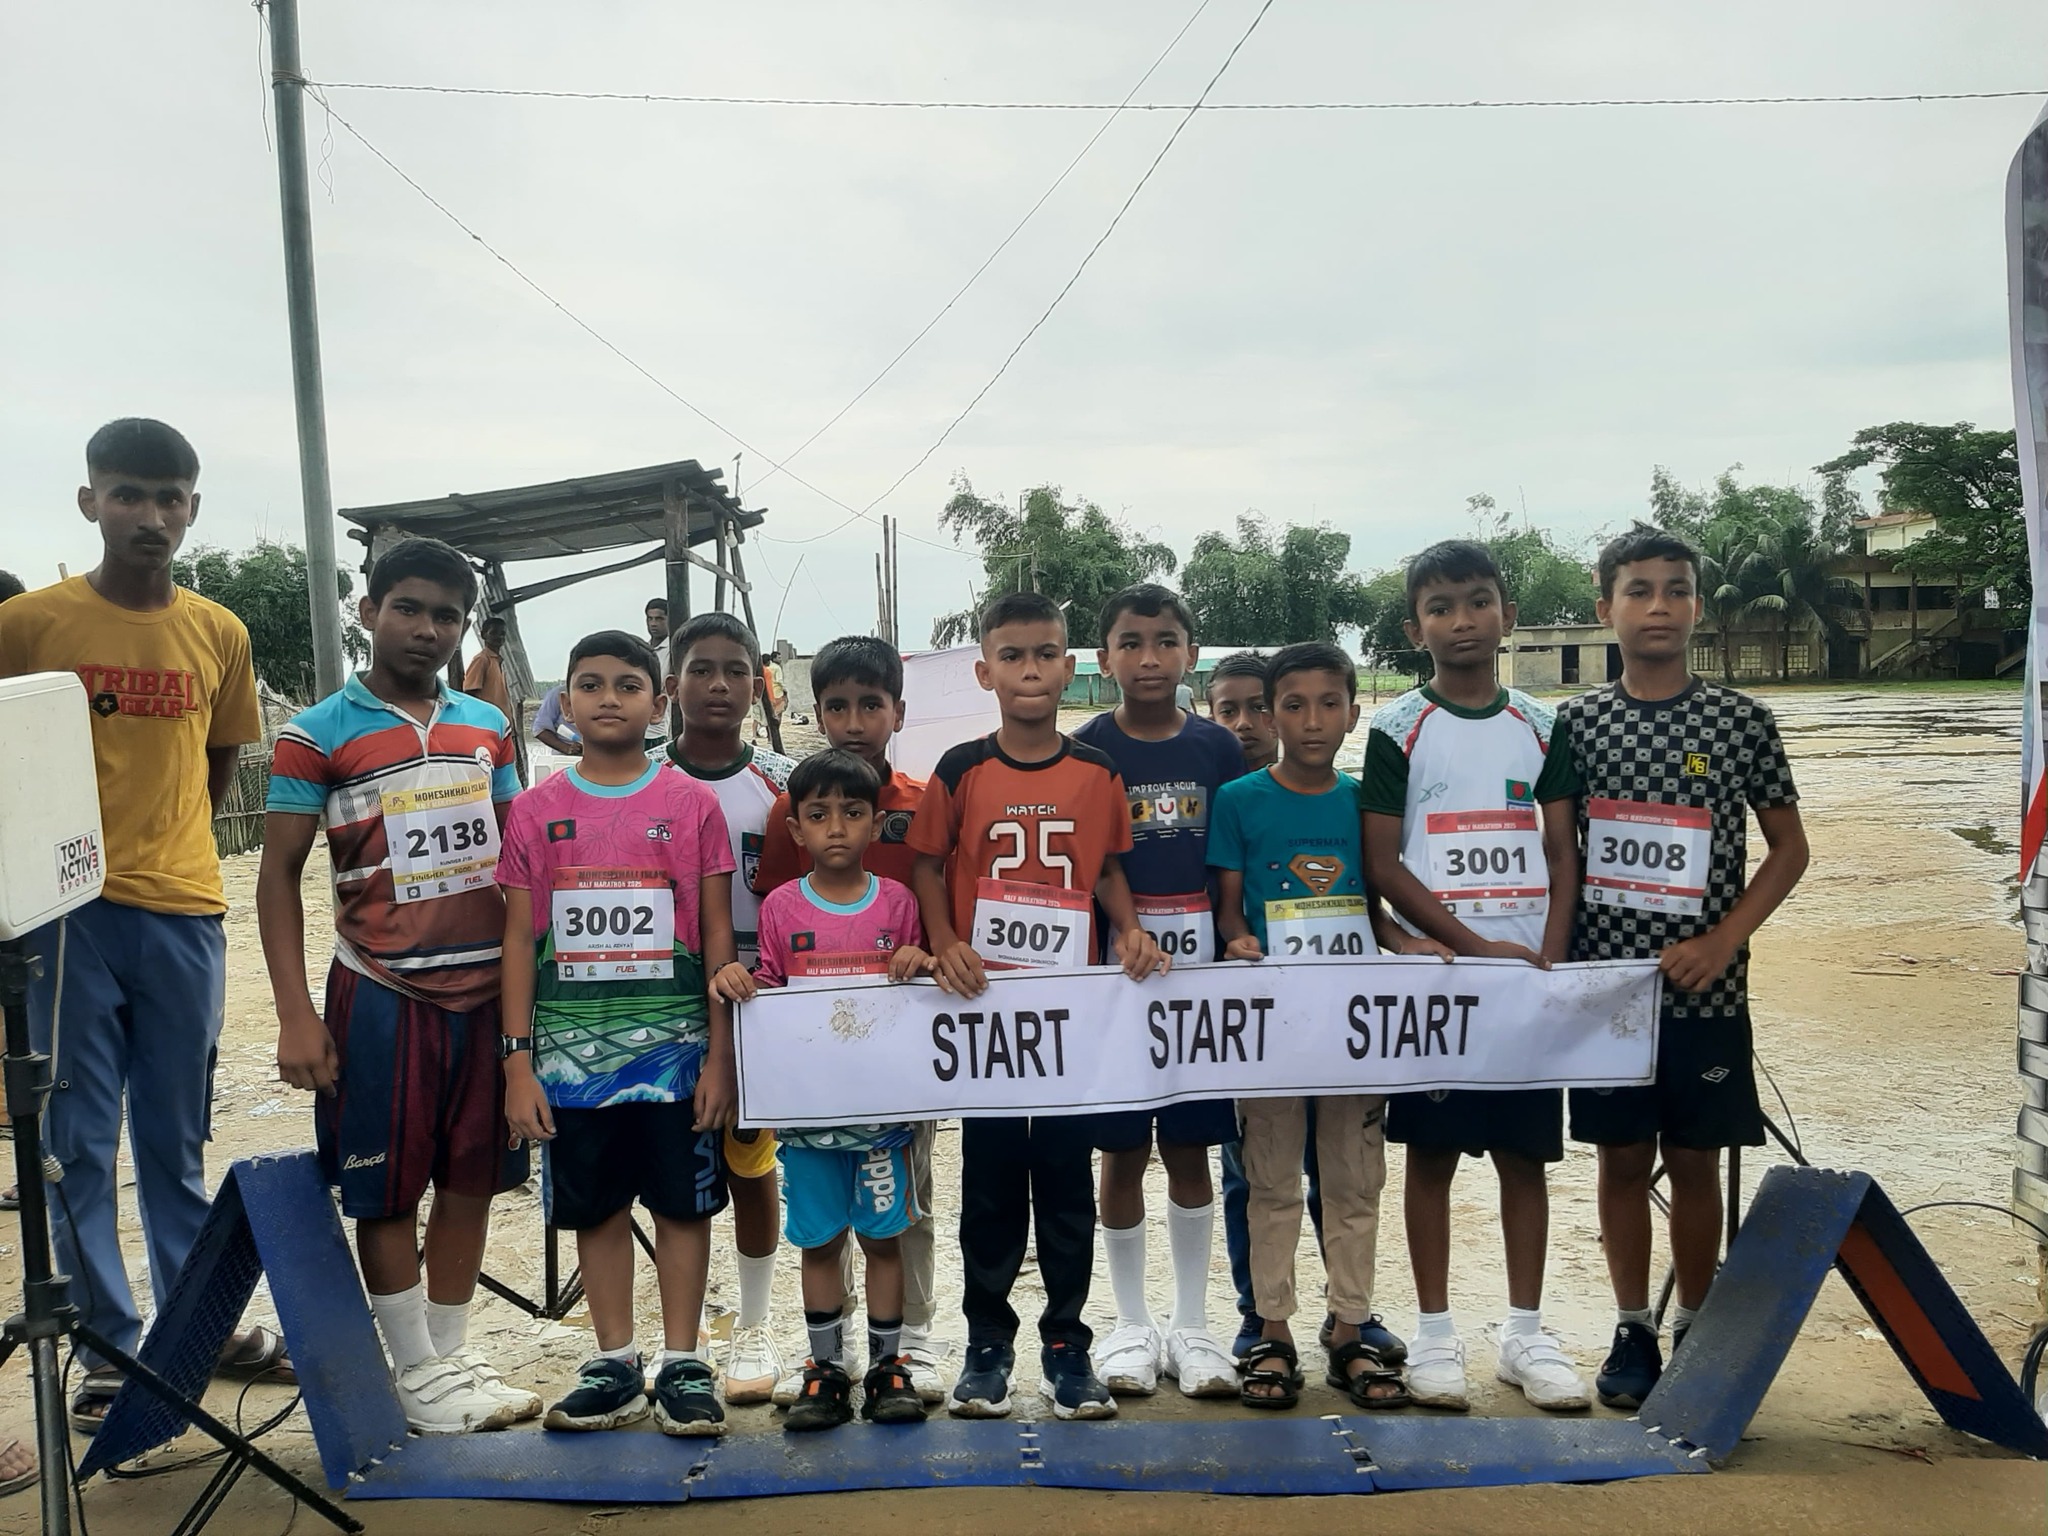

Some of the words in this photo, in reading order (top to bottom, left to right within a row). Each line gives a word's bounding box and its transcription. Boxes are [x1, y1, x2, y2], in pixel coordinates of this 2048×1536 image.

[78, 664, 198, 711] TRIBAL
[120, 696, 184, 718] GEAR
[414, 787, 471, 803] MOHESHKHALI
[1128, 782, 1172, 795] IMPROVE
[1174, 781, 1197, 791] YOUR
[1006, 805, 1057, 816] WATCH
[61, 835, 97, 862] TOTAL
[405, 818, 488, 858] 2138
[1288, 838, 1348, 847] SUPERMAN
[61, 851, 99, 883] ACTIVE
[989, 820, 1075, 890] 25
[1446, 847, 1527, 876] 3001
[1600, 836, 1687, 871] 3008
[61, 869, 100, 894] SPORTS
[464, 875, 484, 886] FUEL
[566, 906, 653, 936] 3002
[987, 918, 1070, 953] 3007
[1147, 928, 1197, 955] 06
[1284, 932, 1363, 955] 2140
[615, 965, 638, 973] FUEL
[932, 1009, 1069, 1082] START
[1147, 998, 1275, 1069] START
[1346, 994, 1480, 1060] START
[694, 1131, 719, 1214] FILA
[861, 1149, 896, 1214] appa
